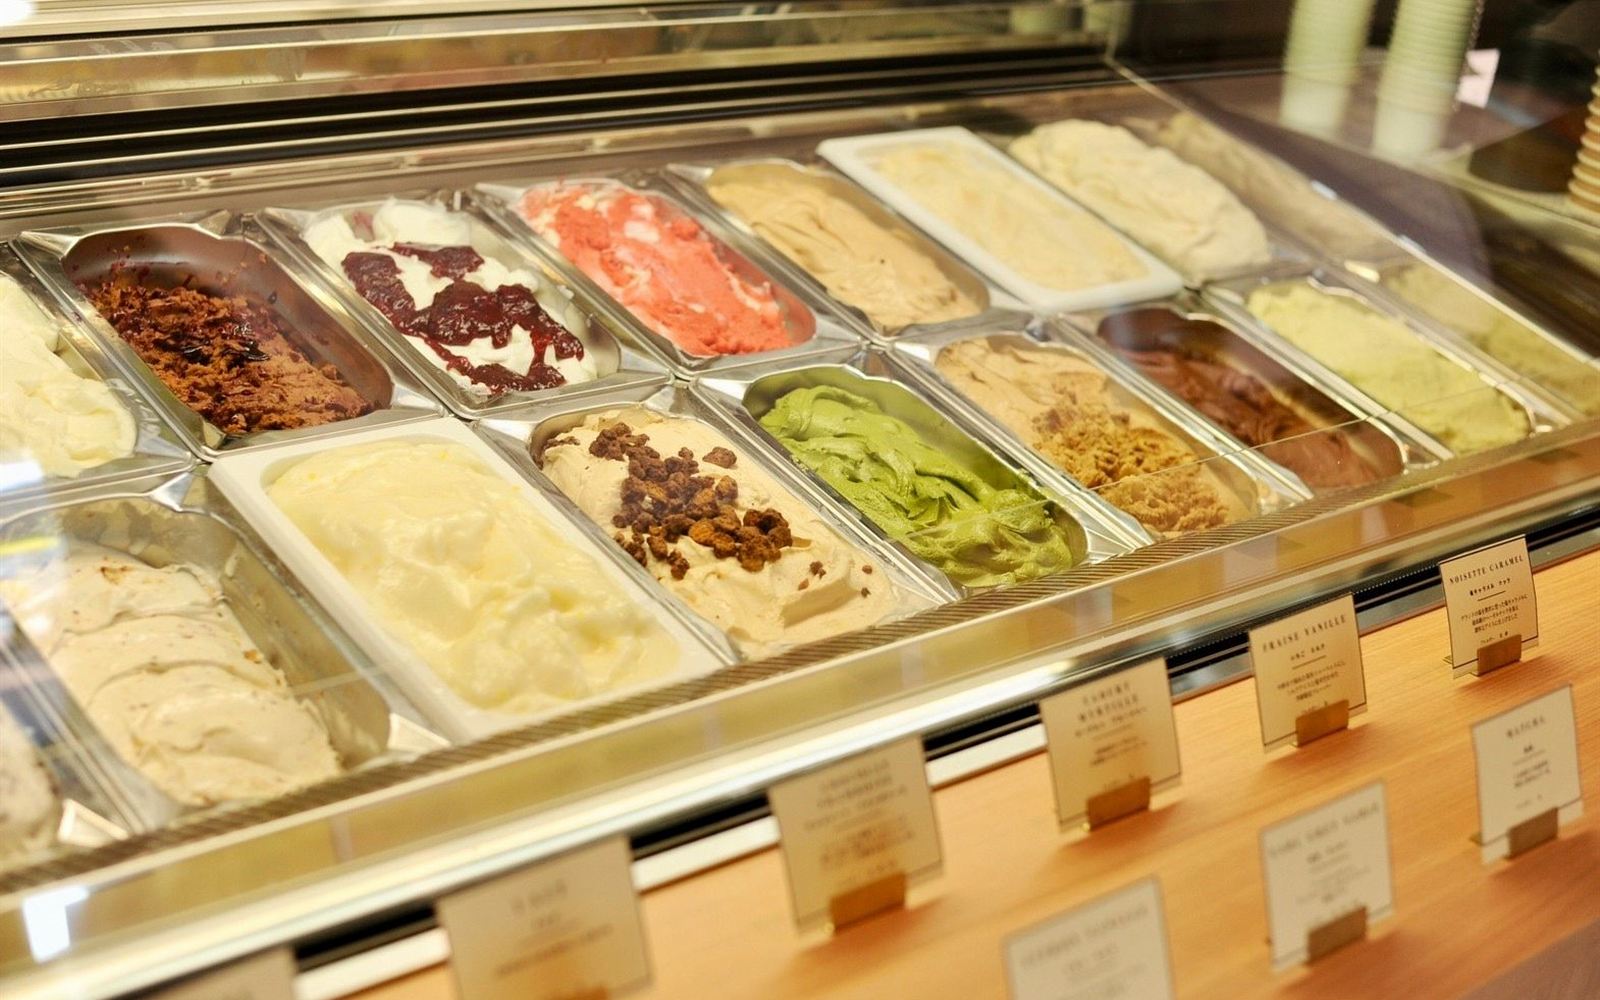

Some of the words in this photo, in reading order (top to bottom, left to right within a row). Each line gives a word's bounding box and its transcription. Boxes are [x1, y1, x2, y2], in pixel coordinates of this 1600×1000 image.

[1449, 567, 1487, 585] NOISETTE
[1489, 555, 1524, 572] CARAMEL
[1262, 632, 1299, 652] FRAISE
[1304, 614, 1346, 636] VANILLE
